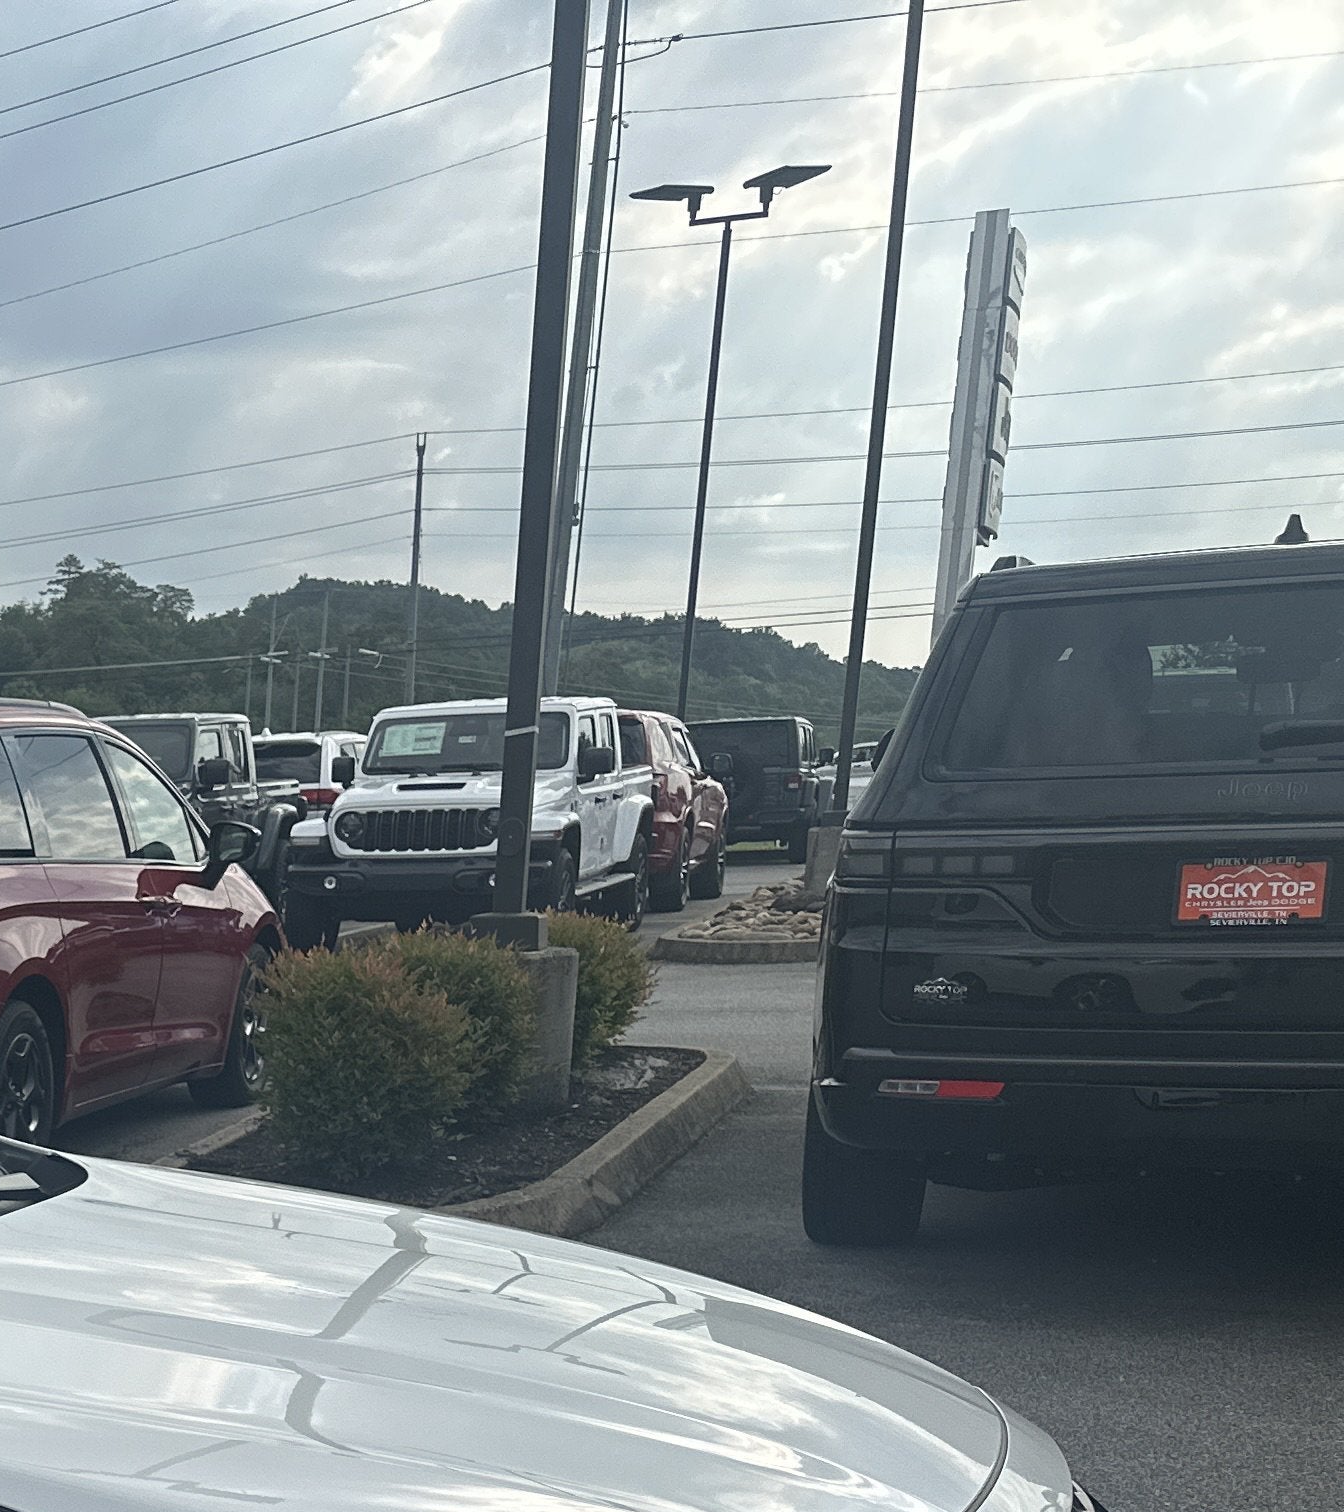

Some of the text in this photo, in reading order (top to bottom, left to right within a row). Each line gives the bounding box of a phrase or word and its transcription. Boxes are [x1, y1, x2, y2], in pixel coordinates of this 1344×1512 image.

[1217, 780, 1309, 800] Jeep
[1186, 881, 1316, 899] ROCKY TOP
[1185, 897, 1316, 908] CHRYSLER Jeep DODGE
[1275, 910, 1287, 918] TN
